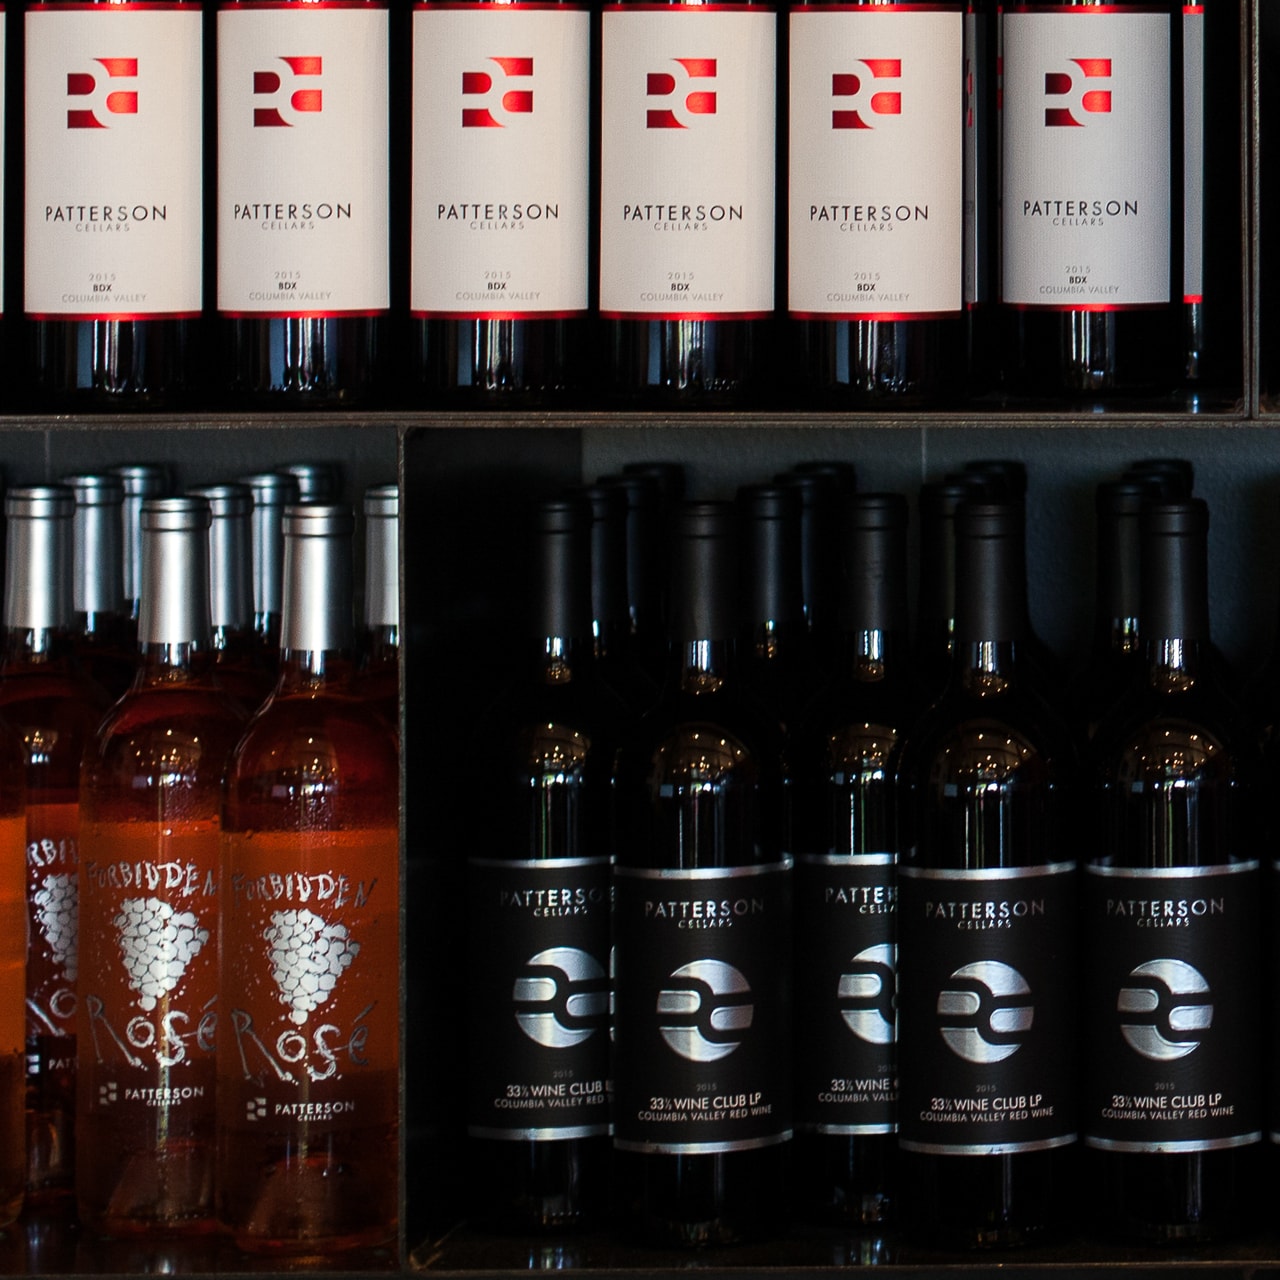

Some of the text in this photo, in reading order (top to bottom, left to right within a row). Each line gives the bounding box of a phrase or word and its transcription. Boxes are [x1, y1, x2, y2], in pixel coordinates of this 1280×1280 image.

[45, 205, 167, 222] PATTERSON
[234, 203, 351, 220] PATTERSON
[437, 203, 559, 220] PATTERSON
[624, 204, 743, 222] PATTERSON
[810, 205, 928, 222] PATTERSON
[1024, 200, 1138, 216] PATTERSON
[75, 223, 130, 232] CELLARS
[262, 221, 315, 231] CELLARS
[470, 221, 525, 231] CELLARS
[654, 222, 708, 232] CELLARS
[840, 222, 894, 232] CELLARS
[1052, 216, 1104, 226] CELLARS
[645, 899, 764, 918] PATTERSON
[926, 899, 1044, 919] PATTERSON
[1107, 898, 1224, 917] PATTERSON
[125, 1086, 204, 1099] PATTERSON
[275, 1101, 354, 1115] PATTERSON
[674, 1096, 709, 1109] WINE
[713, 1095, 747, 1109] CLUB
[749, 1093, 761, 1106] LP
[954, 1095, 1042, 1111] WINE CLUB LP
[638, 1104, 772, 1121] COLUMBIA VALLEY RED WINE
